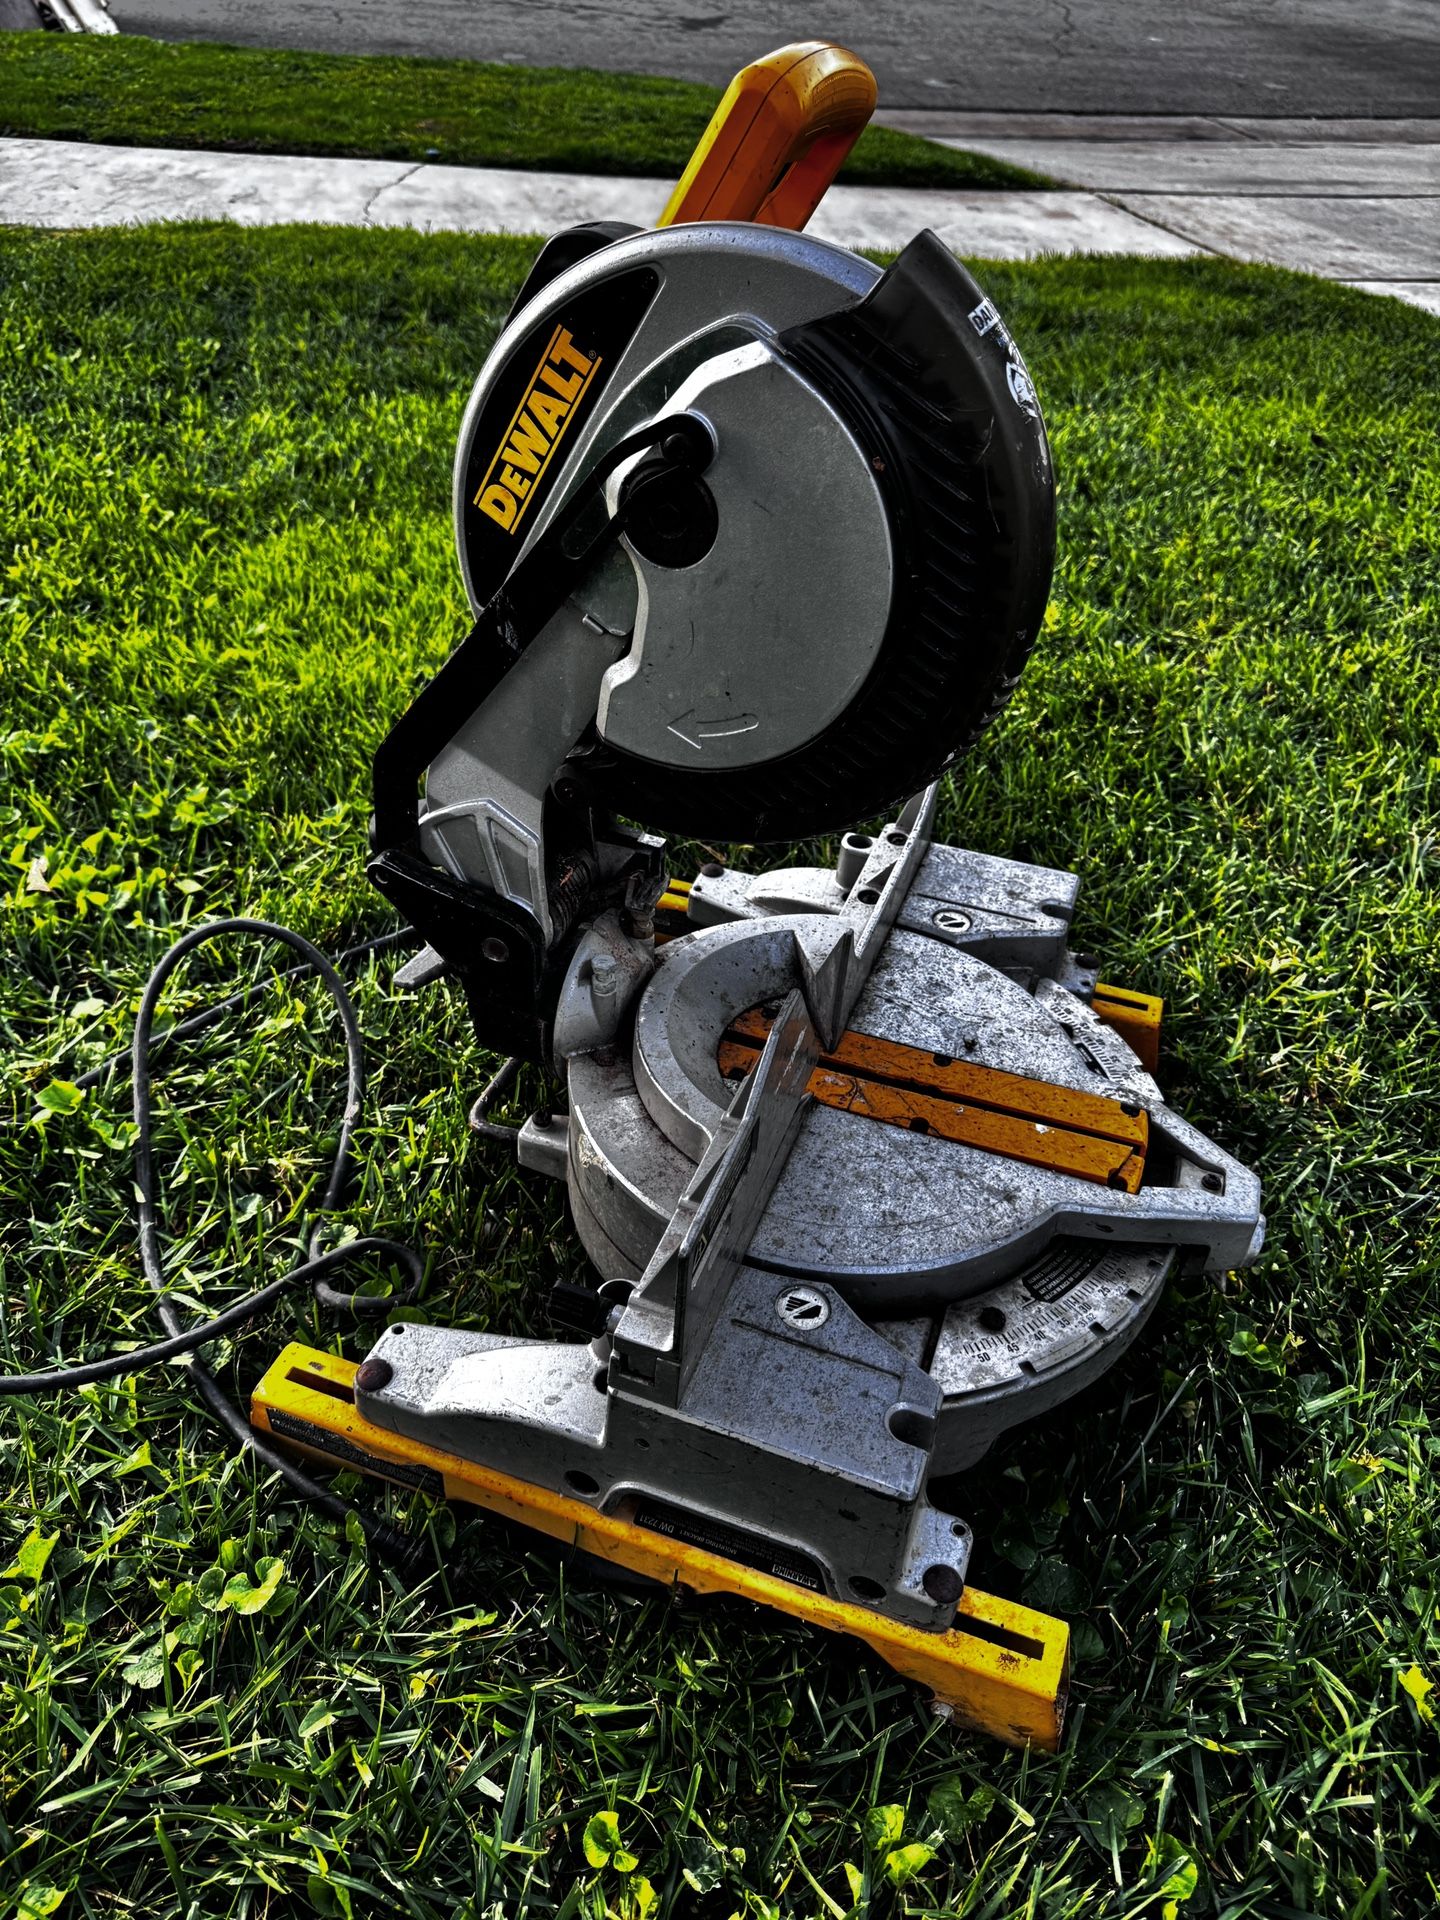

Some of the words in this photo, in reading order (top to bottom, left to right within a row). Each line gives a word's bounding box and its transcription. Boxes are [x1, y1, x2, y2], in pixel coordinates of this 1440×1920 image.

[977, 1352, 991, 1363] 50
[1006, 1342, 1020, 1353] 45
[1033, 1330, 1046, 1341] 40
[1057, 1317, 1070, 1328] 35
[1079, 1302, 1092, 1313] 30
[1098, 1285, 1111, 1297] 25
[1113, 1268, 1127, 1278] 20
[658, 1520, 675, 1533] DW
[773, 1564, 810, 1584] WARNING
